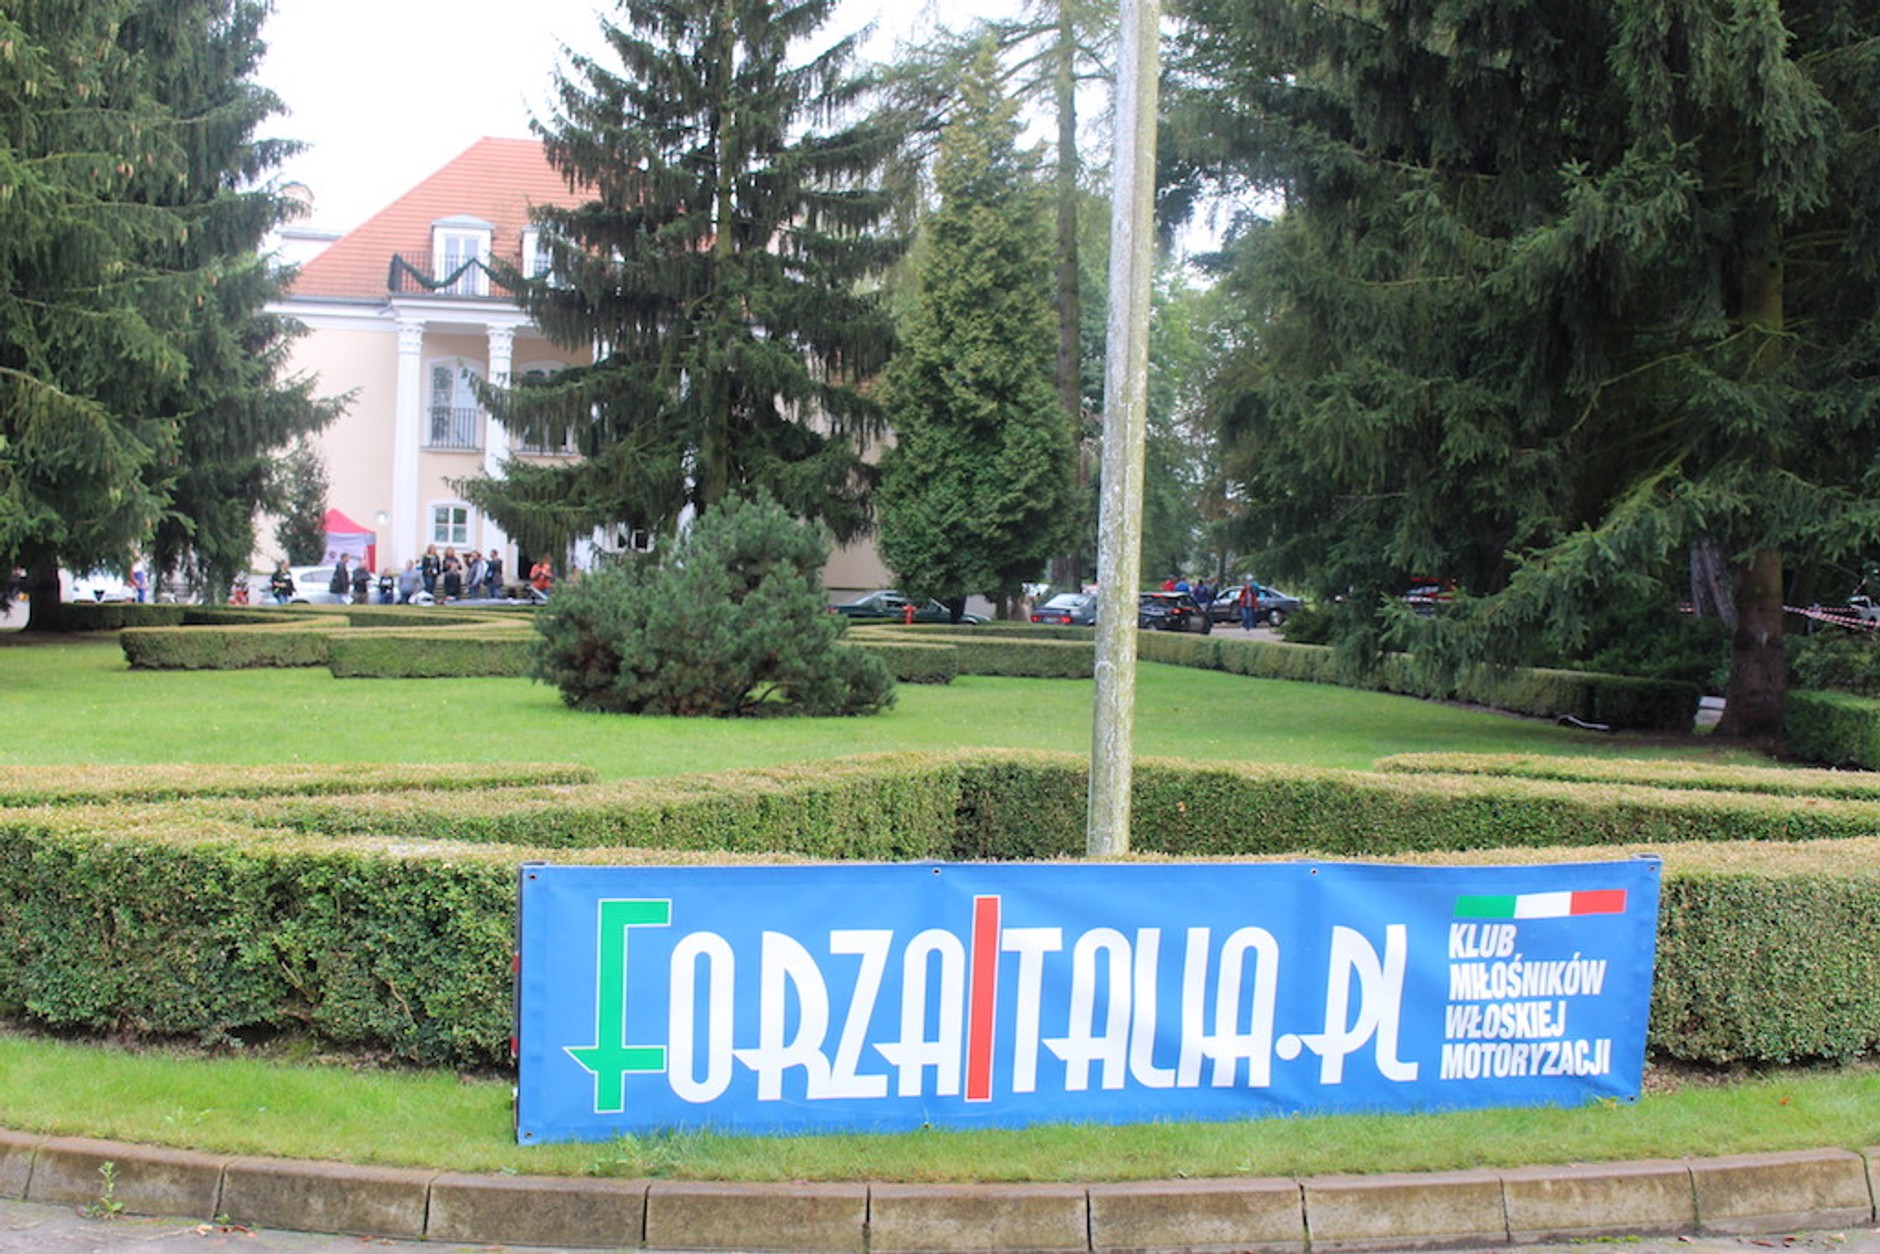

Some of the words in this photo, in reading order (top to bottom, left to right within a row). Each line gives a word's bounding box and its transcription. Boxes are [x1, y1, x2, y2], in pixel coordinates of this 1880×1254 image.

[1448, 923, 1517, 959] KLUB
[1448, 951, 1607, 1000] MIŁOŚNIKÓW
[1445, 1000, 1566, 1039] WŁOSKIEJ
[1440, 1039, 1611, 1080] MOTORYZACJI
